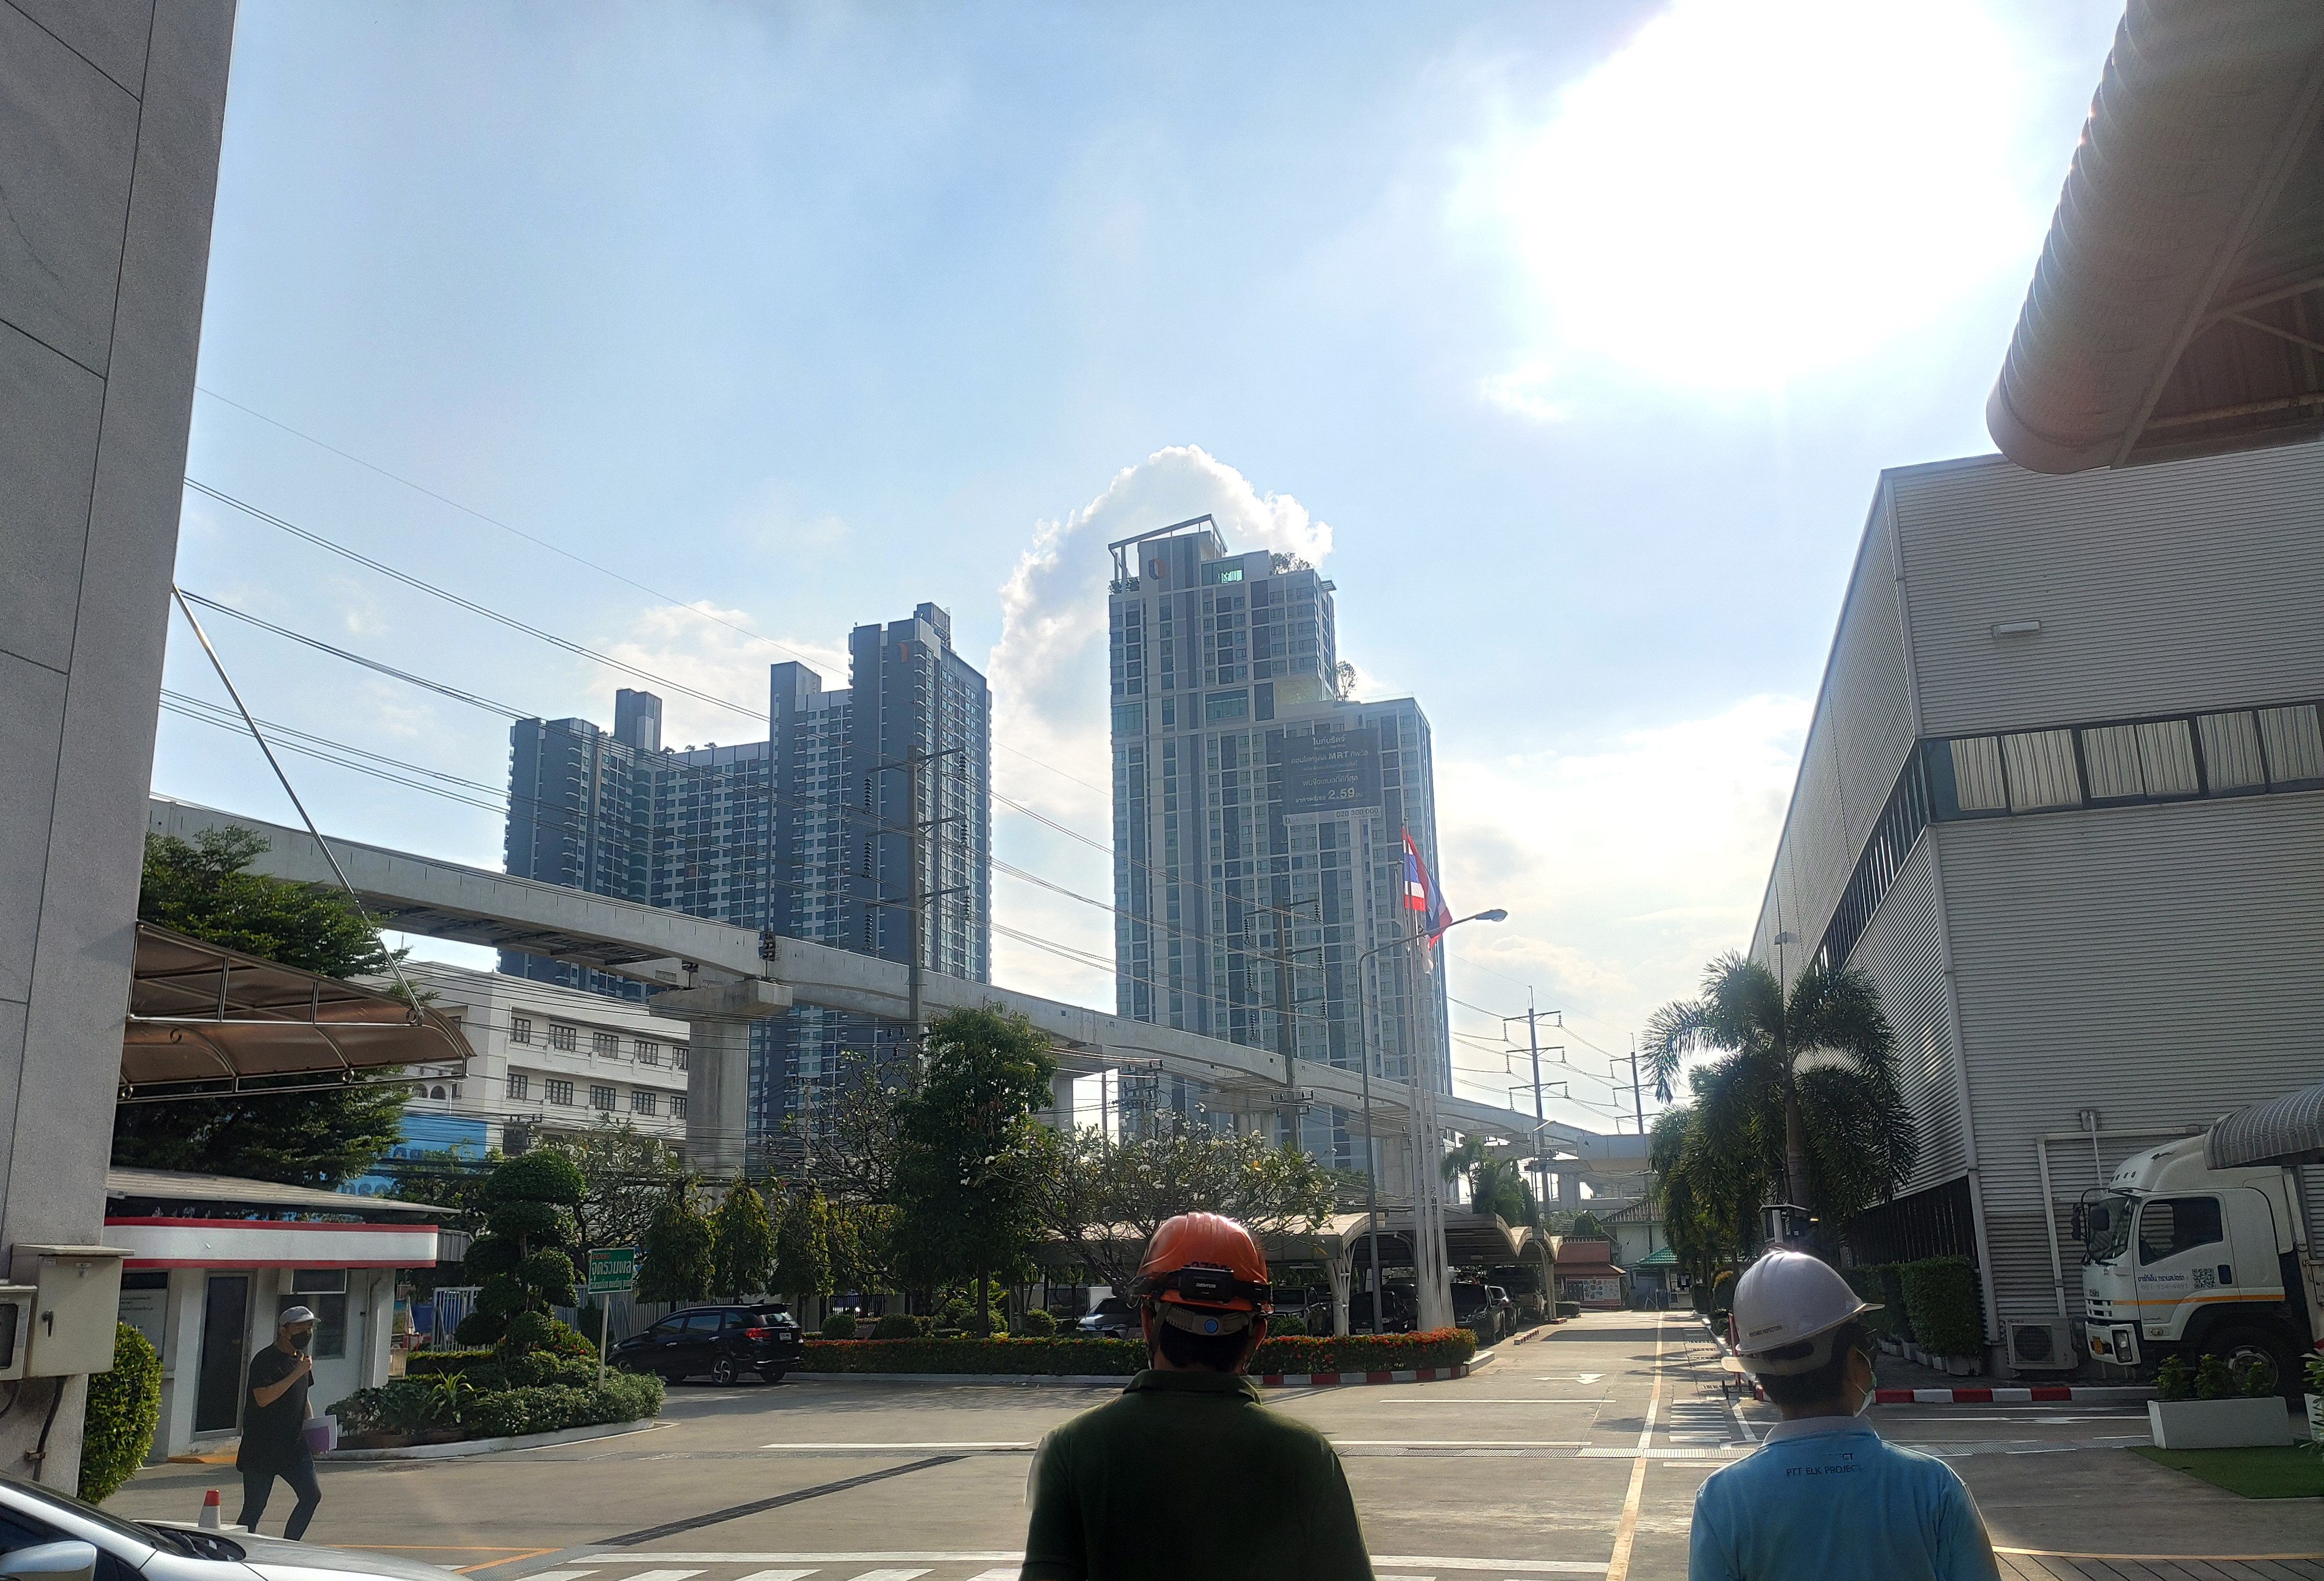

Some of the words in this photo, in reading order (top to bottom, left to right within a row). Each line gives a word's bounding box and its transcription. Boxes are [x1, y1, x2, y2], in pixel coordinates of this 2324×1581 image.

[1328, 750, 1349, 760] MRT
[1328, 787, 1355, 800] 2.59
[592, 1260, 632, 1281] จุดรวมพล
[1786, 1468, 1802, 1476] PTT
[1806, 1467, 1821, 1475] ELK
